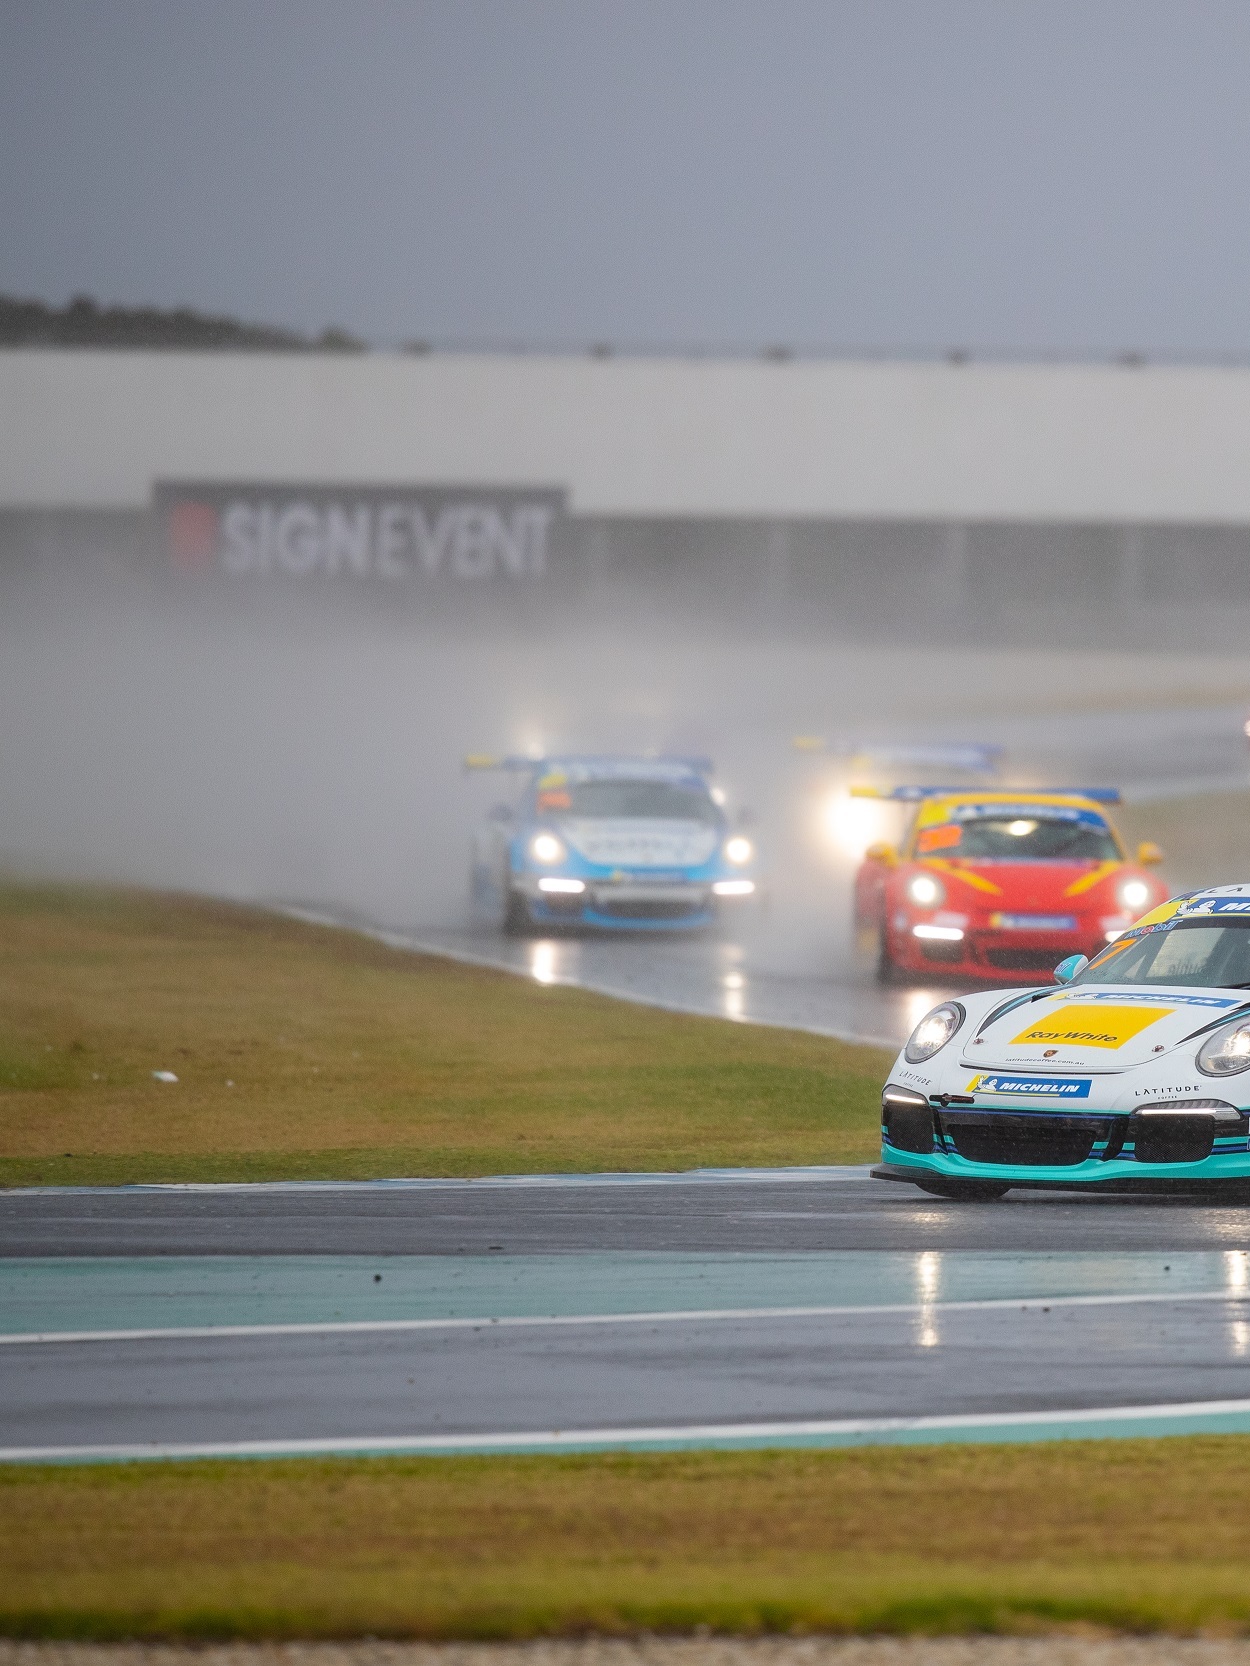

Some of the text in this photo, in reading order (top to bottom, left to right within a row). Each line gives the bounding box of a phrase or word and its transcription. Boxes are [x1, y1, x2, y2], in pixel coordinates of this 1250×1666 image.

[1124, 919, 1183, 939] Mobil
[1089, 938, 1137, 970] 7
[1005, 1058, 1085, 1066] latitudecoffee.com.au
[999, 1083, 1080, 1093] MICHELIN
